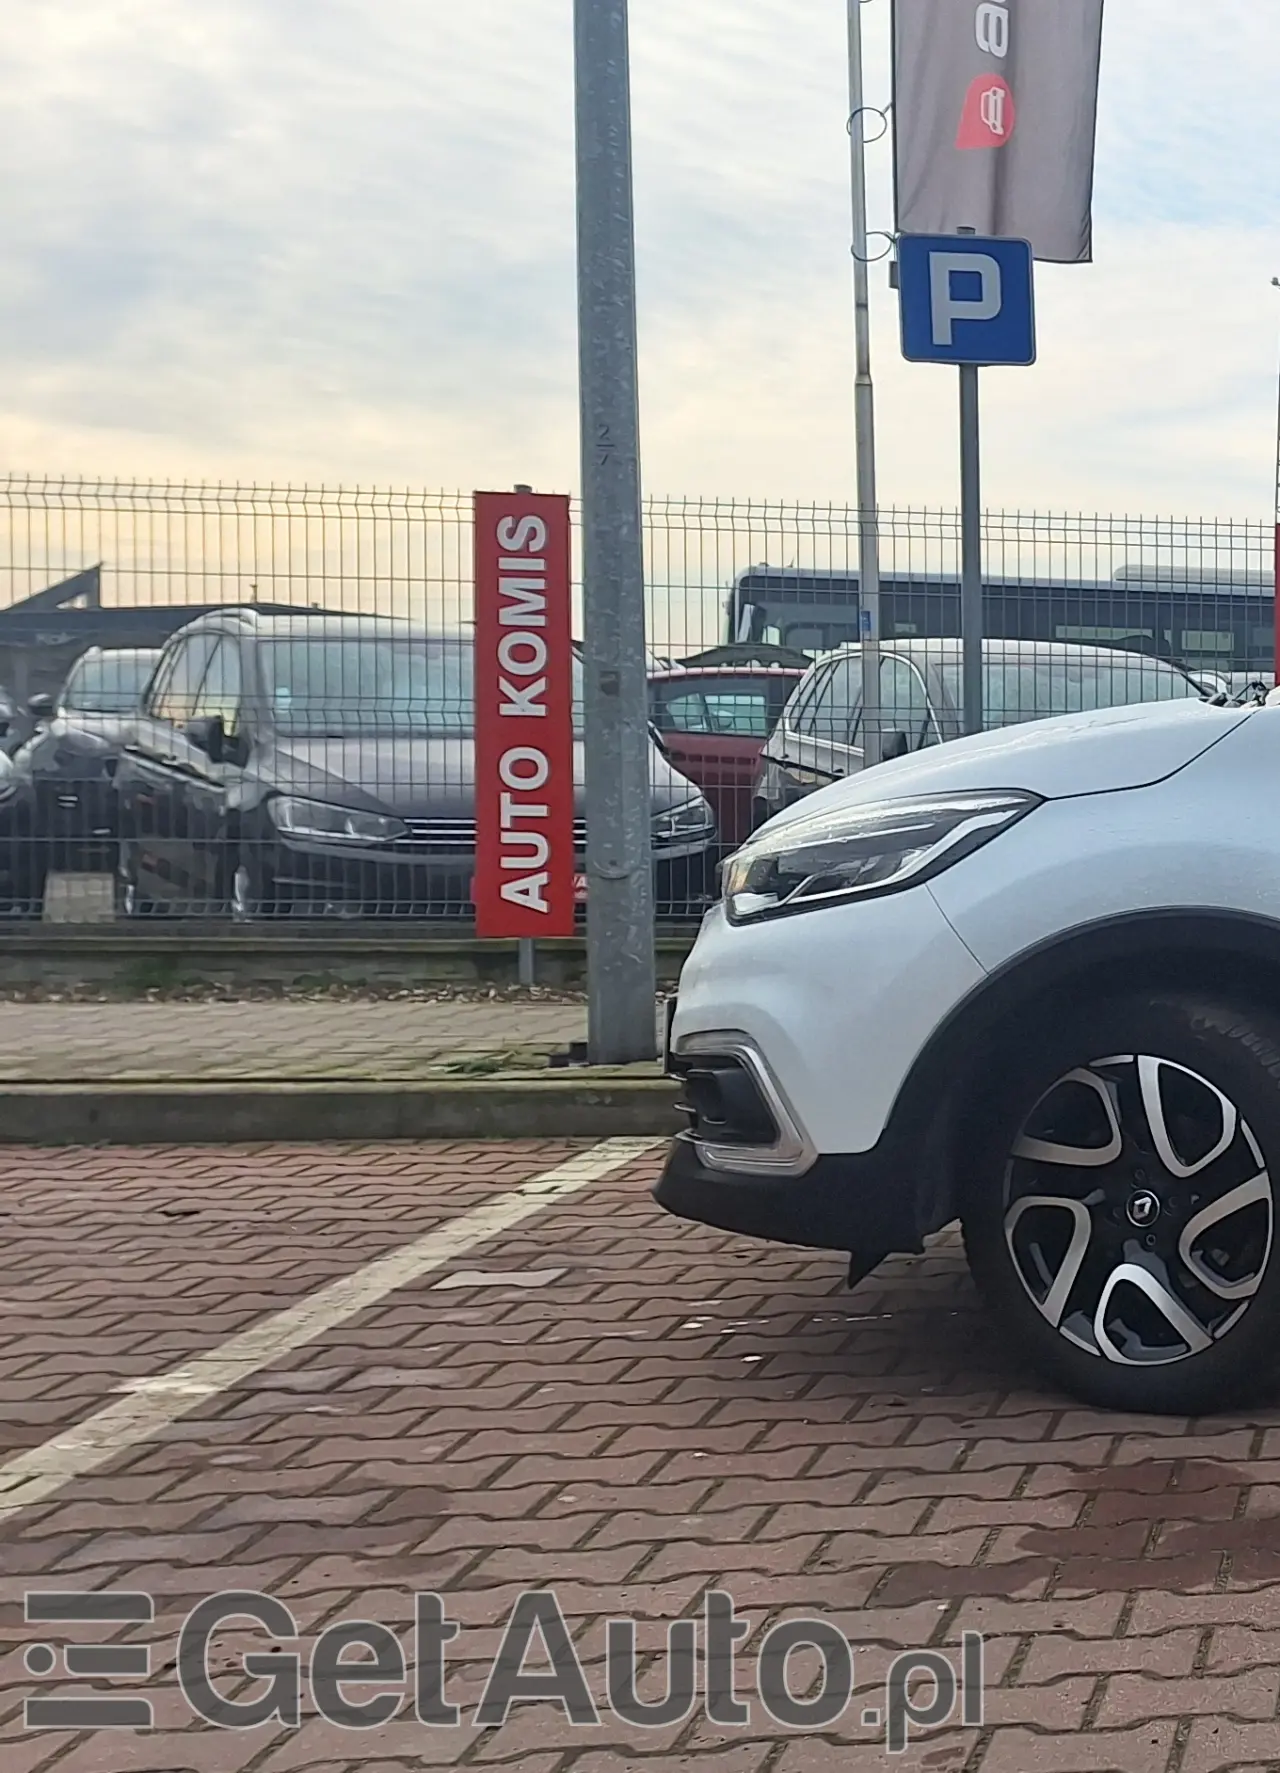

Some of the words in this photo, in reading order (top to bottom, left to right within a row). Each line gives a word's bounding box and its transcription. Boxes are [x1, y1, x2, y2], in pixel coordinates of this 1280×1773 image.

[975, 0, 1008, 58] a
[929, 251, 1001, 345] P
[497, 514, 547, 716] KOMIS
[499, 746, 549, 913] AUTO
